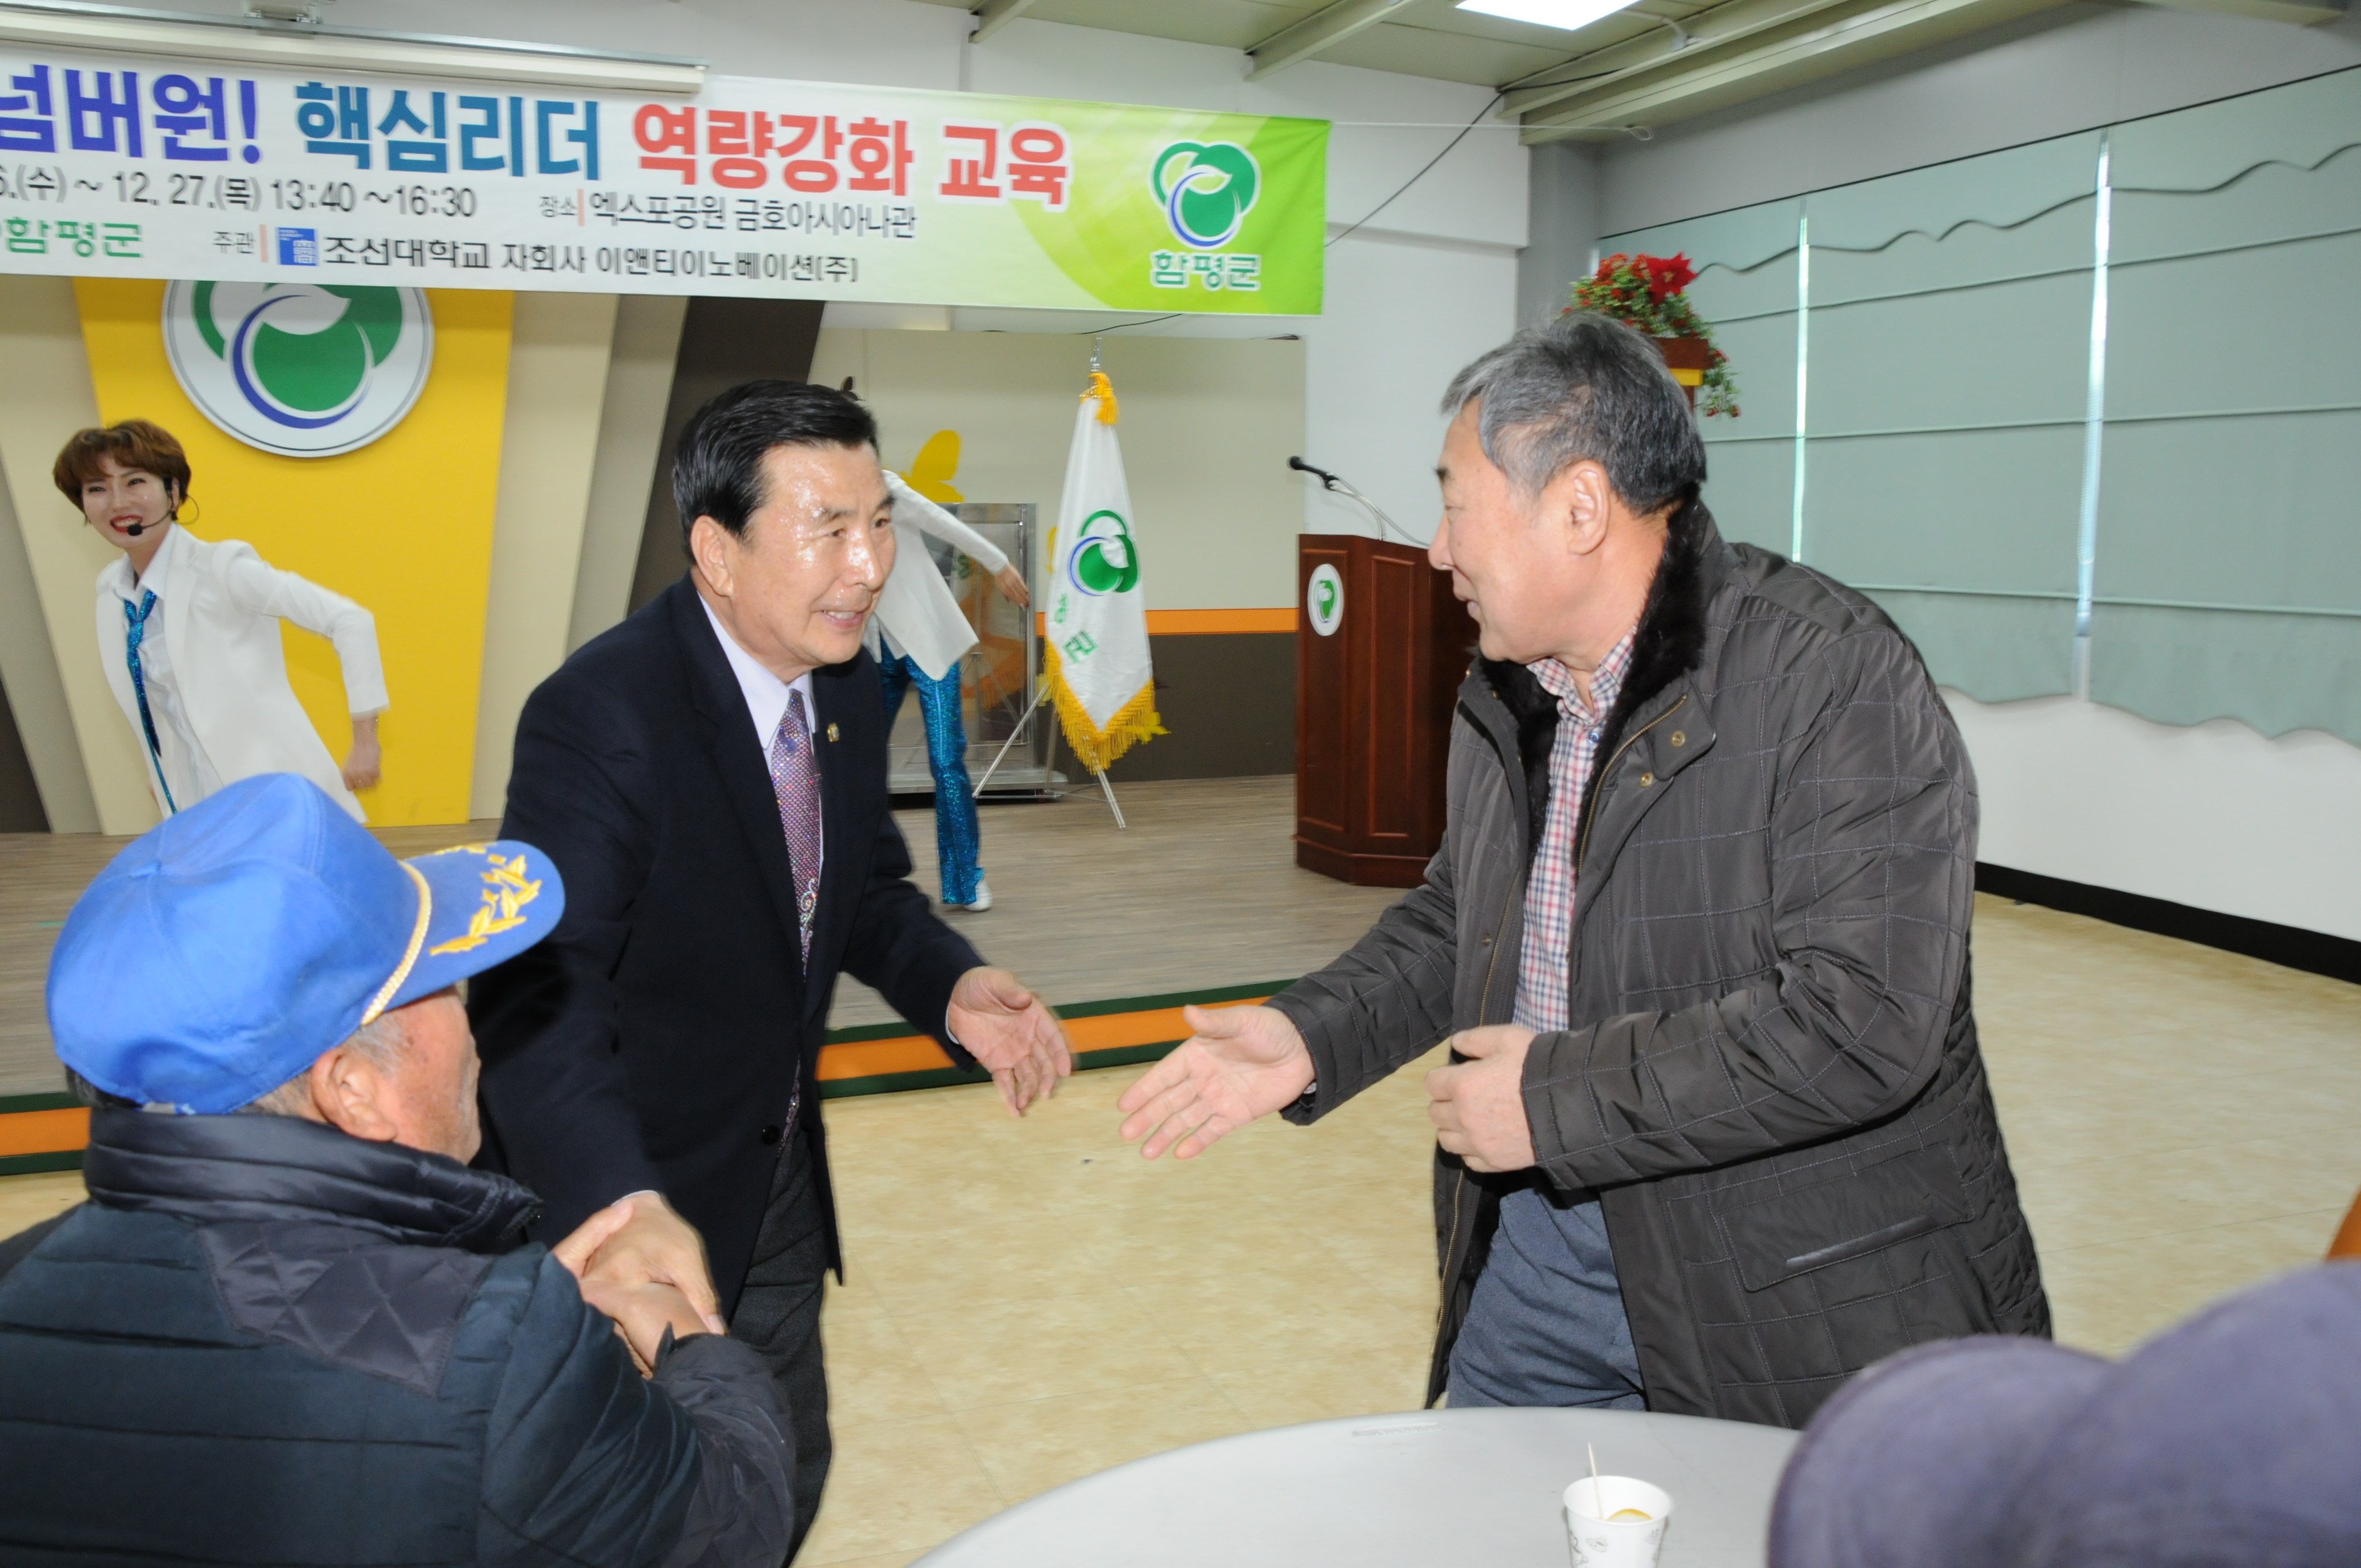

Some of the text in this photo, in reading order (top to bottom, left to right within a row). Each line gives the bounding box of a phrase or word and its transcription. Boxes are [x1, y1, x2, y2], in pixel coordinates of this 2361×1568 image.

[0, 64, 1069, 204] 넘버원! 핵심리더 역량강화 교육
[270, 179, 356, 212] 13:40
[539, 192, 917, 238] 장소 엑스포공원 금호아시아나관
[5, 217, 143, 258] 함평군
[213, 231, 255, 254] 주관
[324, 237, 492, 268] 조선대학교
[501, 244, 587, 273] 자회사
[1155, 252, 1256, 288] 함평군
